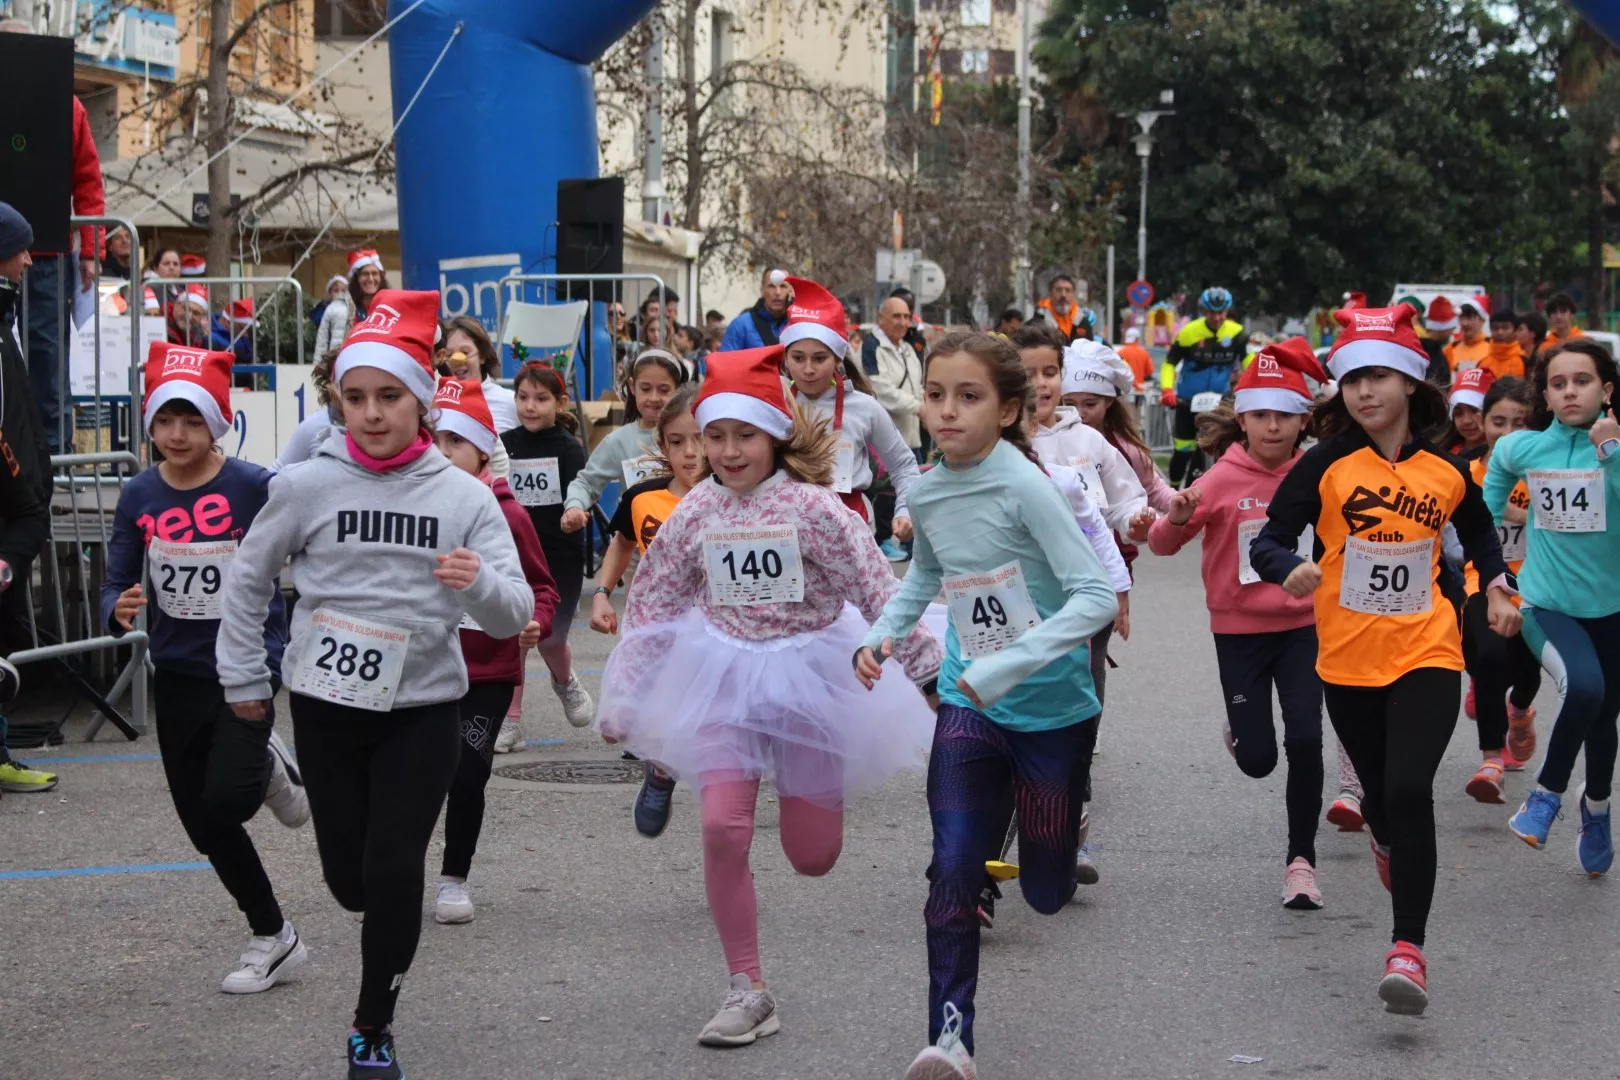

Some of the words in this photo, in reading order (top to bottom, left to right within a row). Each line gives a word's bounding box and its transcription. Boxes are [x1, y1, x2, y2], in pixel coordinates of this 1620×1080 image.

[440, 267, 522, 319] bnf
[1258, 354, 1280, 370] bn
[293, 382, 305, 425] 1
[233, 409, 247, 459] 2
[513, 472, 549, 491] 246
[1540, 487, 1590, 512] 314
[337, 510, 439, 550] PUMA
[1367, 530, 1405, 543] club
[160, 563, 221, 595] 279
[722, 548, 783, 581] 140
[1368, 564, 1410, 593] 50
[971, 595, 1008, 629] 49
[355, 624, 383, 638] SOLIDARIA
[315, 636, 383, 682] 288
